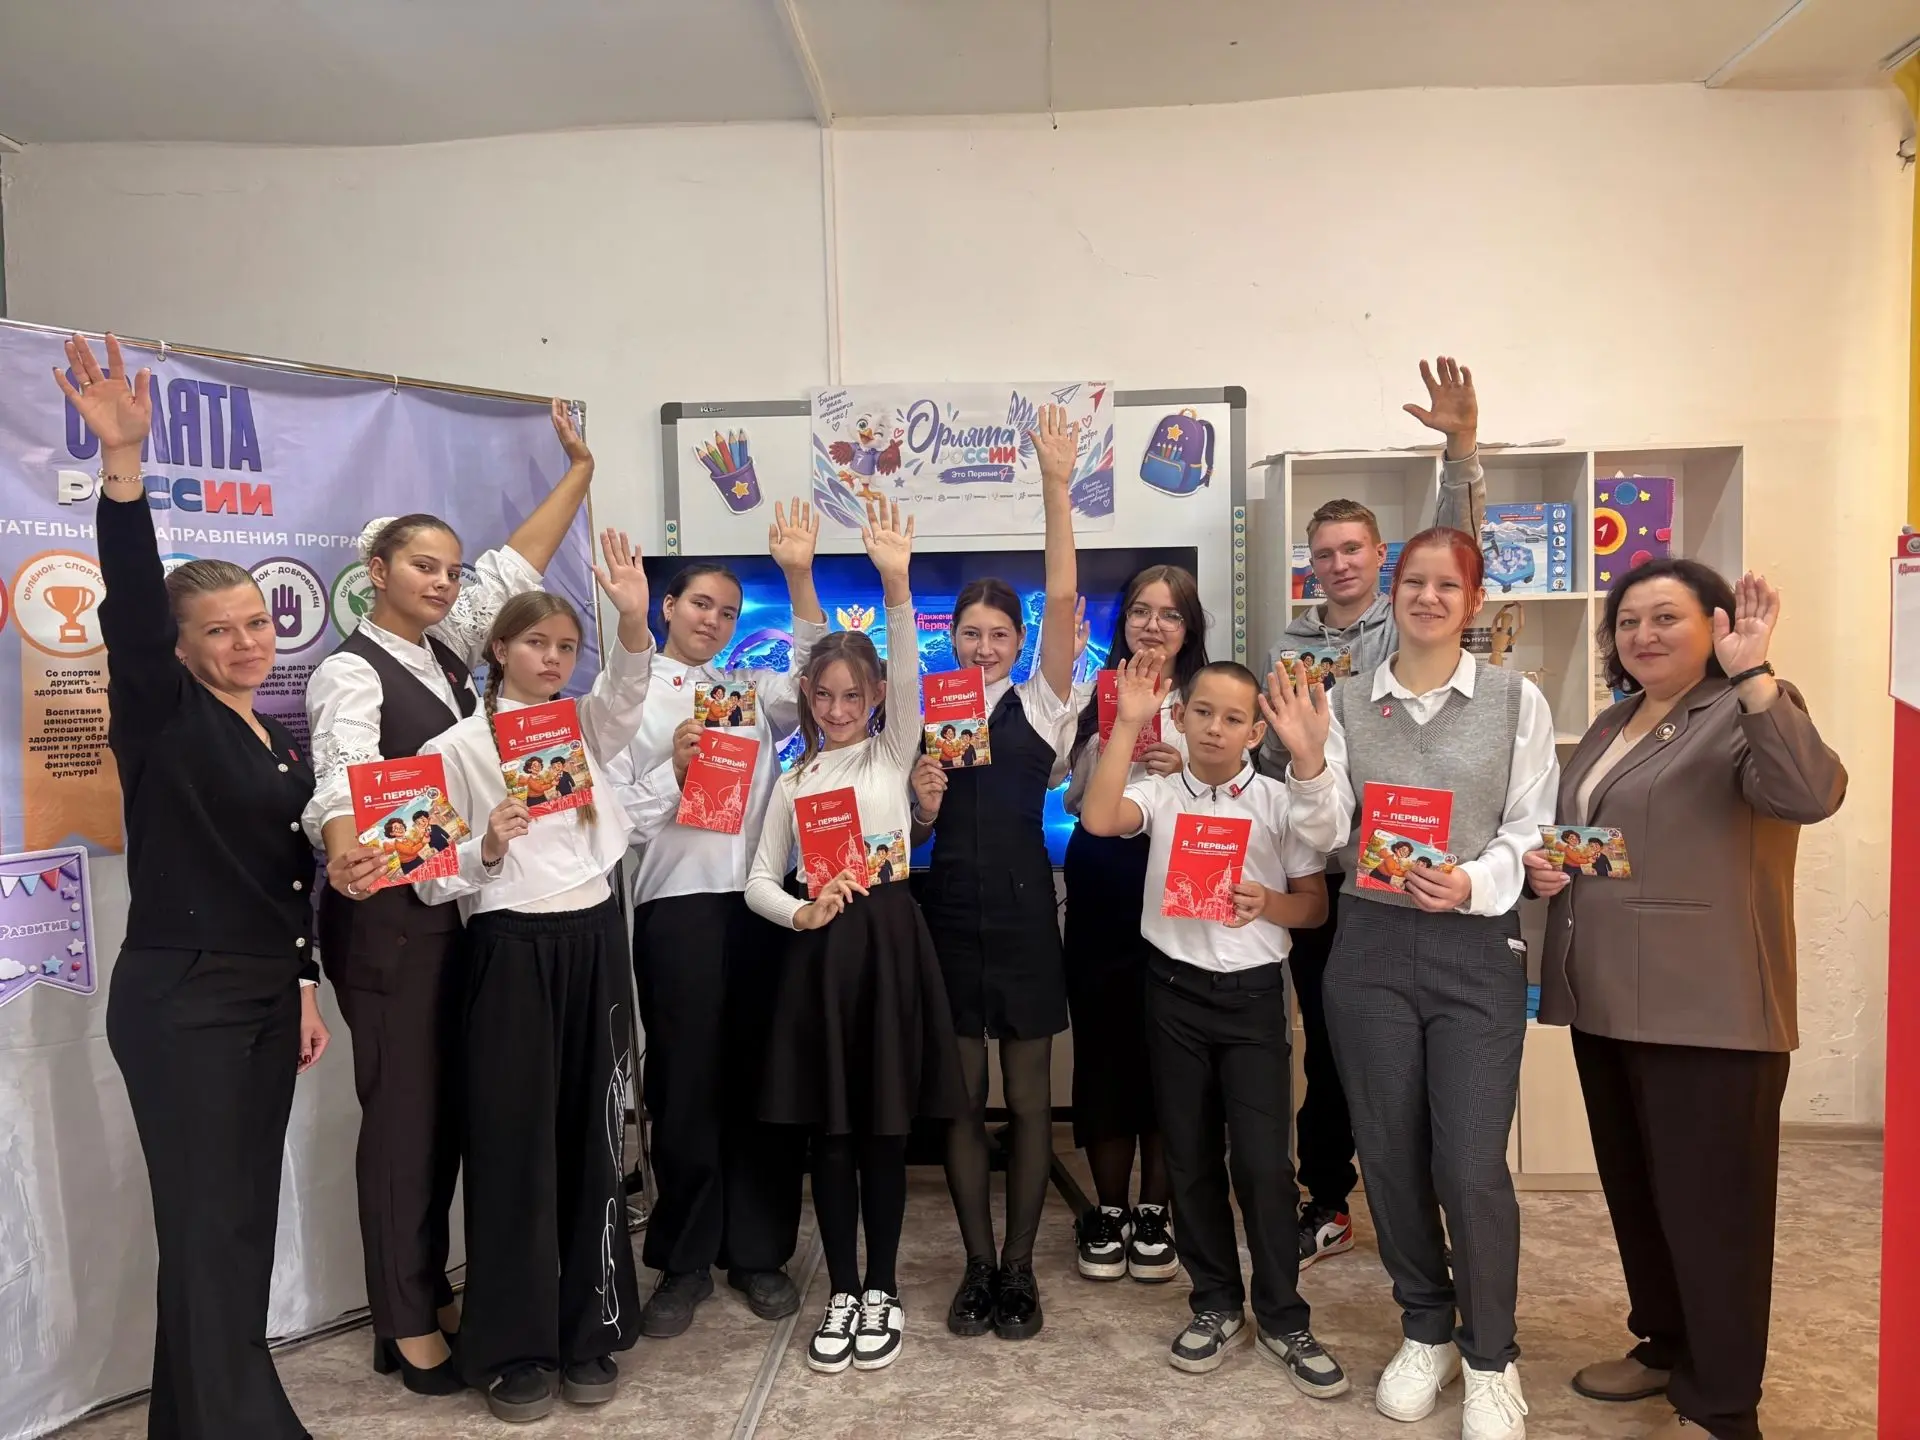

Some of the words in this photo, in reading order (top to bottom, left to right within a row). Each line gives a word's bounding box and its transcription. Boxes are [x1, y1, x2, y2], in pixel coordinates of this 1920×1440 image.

[65, 367, 262, 472] ОЛЯТА
[907, 399, 1016, 464] Орлята
[940, 446, 1016, 464] РОССИИ
[951, 470, 966, 479] Это
[967, 470, 999, 480] Первые
[57, 470, 274, 517] РССИИ
[0, 519, 95, 539] ТАТЕЛЬН
[156, 527, 288, 546] АПРАВЛЕНИЯ
[295, 533, 358, 549] ПРОГРА
[23, 563, 56, 601] ОРЛЁНОК
[64, 561, 106, 588] СПОРТС
[278, 566, 320, 608] ДОБРОВОЛЕЦ
[917, 613, 952, 621] Движени
[917, 620, 951, 632] Первы
[45, 669, 59, 678] Со
[61, 669, 101, 679] спортом
[50, 679, 90, 687] дружить
[34, 688, 83, 697] здоровым
[943, 691, 977, 703] ПЕРВЫЙ!
[45, 708, 102, 717] Воспитание
[43, 717, 104, 726] ценностного
[43, 726, 97, 734] отношения
[28, 735, 82, 744] здоровому
[85, 733, 108, 741] обра
[508, 739, 517, 747] Я
[525, 727, 571, 743] ПЕРВЫЙ!
[29, 744, 60, 752] жизни
[71, 742, 109, 751] привит
[47, 752, 91, 760] интереса
[44, 759, 102, 770] физической
[711, 755, 748, 769] ПЕРВЫЙ!
[52, 768, 98, 778] культуре!
[363, 795, 372, 804] Я
[383, 785, 430, 800] ПЕРВЫ
[818, 812, 852, 826] ПЕРВЫЙ!
[1372, 810, 1380, 818] Я
[1390, 812, 1440, 825] ПЕРВЫЙ!
[1197, 841, 1239, 851] ПЕРВЫЙ!
